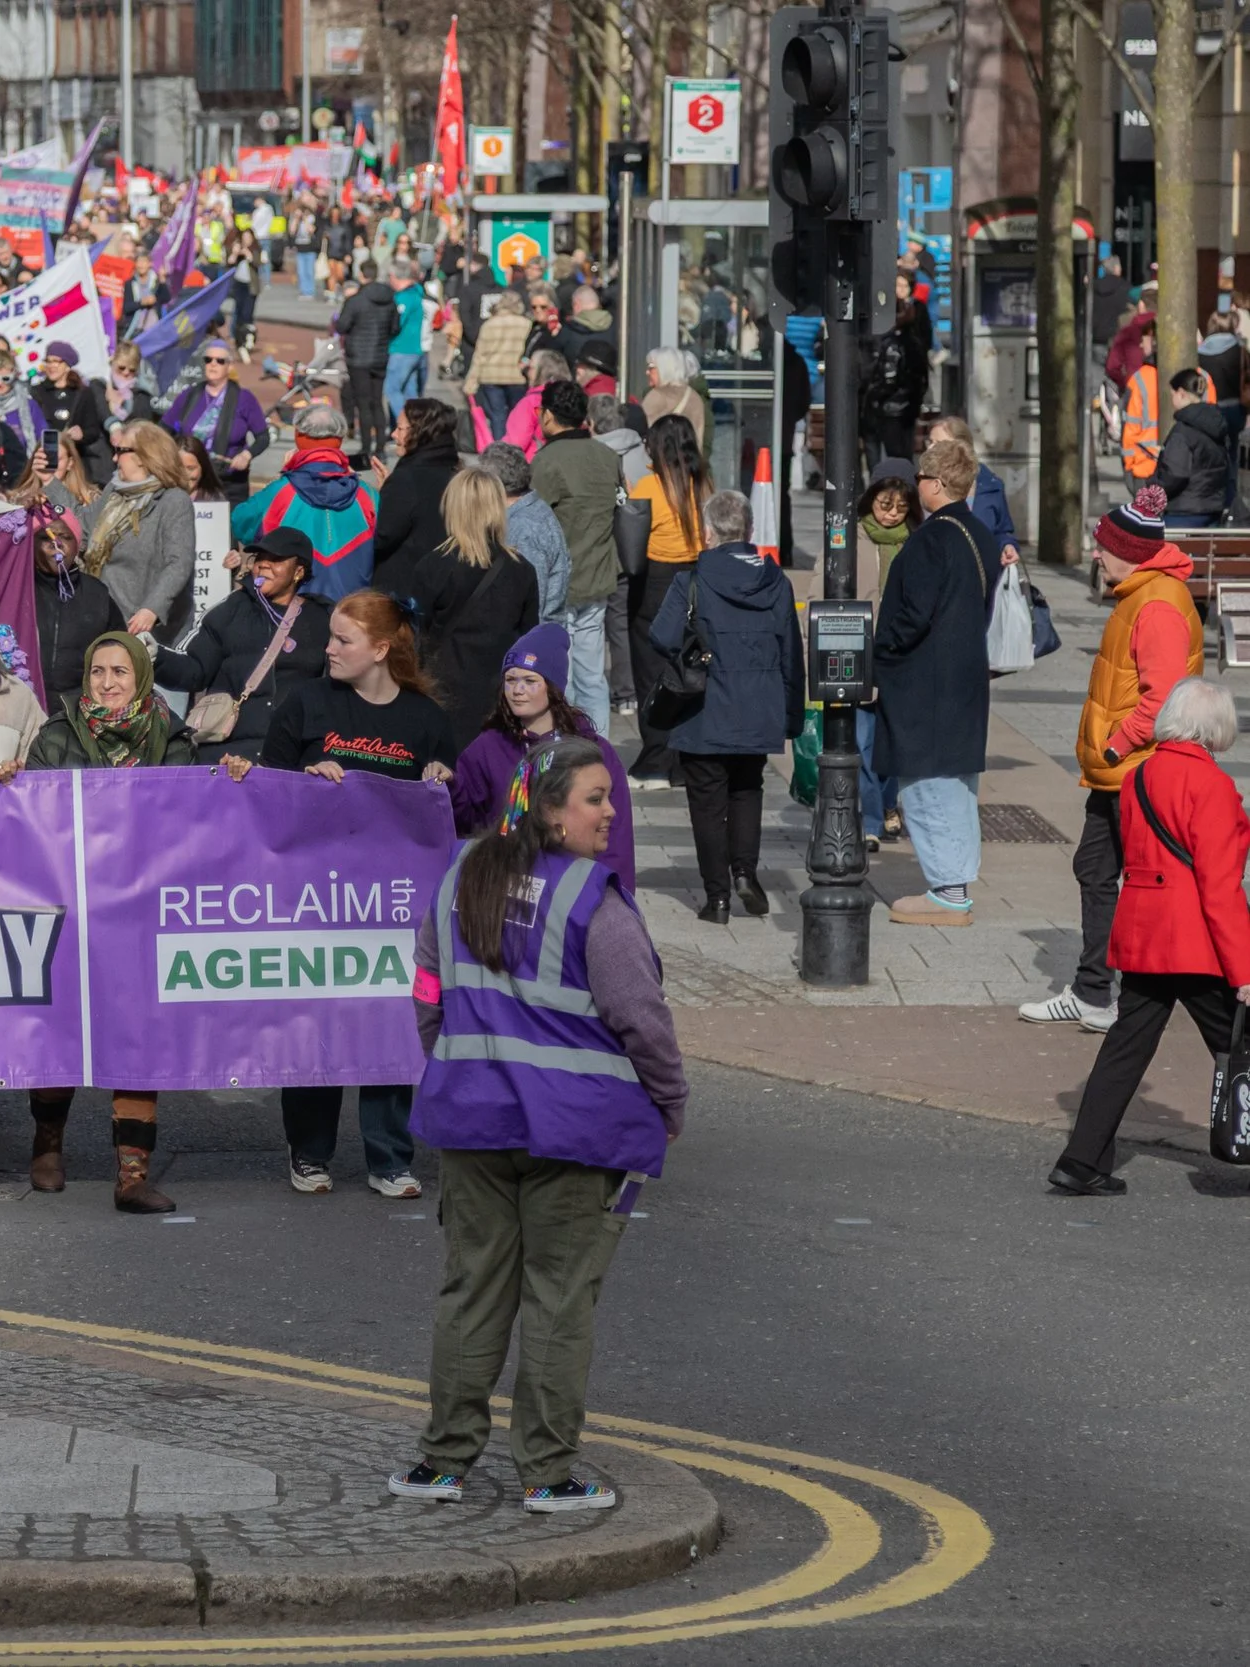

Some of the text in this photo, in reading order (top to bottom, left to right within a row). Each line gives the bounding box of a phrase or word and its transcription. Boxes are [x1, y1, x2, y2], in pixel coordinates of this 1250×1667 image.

[698, 104, 714, 126] 2
[330, 749, 413, 766] NORTHERN IRELAND
[160, 871, 416, 926] RECLAIM the
[164, 945, 410, 991] AGENDA
